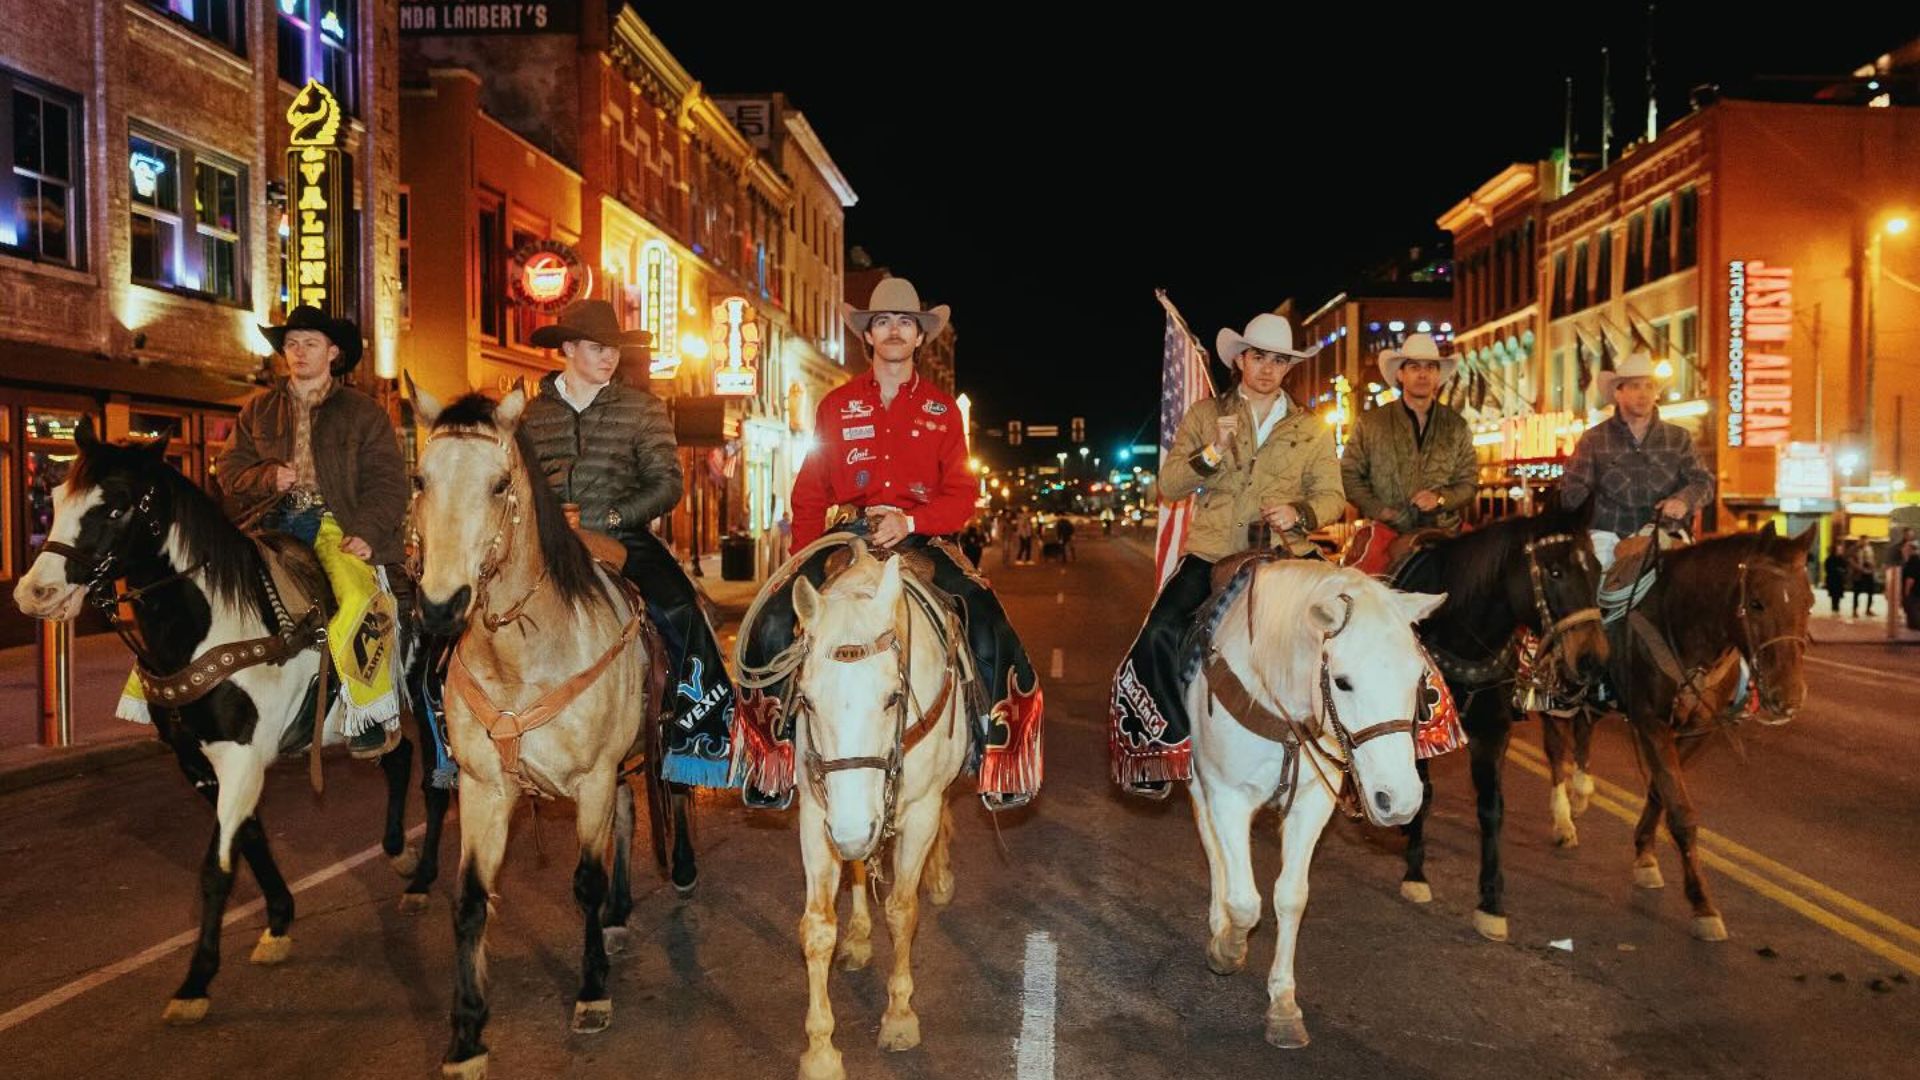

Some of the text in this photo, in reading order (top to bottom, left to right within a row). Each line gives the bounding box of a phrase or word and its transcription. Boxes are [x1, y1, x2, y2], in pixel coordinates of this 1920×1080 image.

[444, 5, 547, 29] LAMBERT'S
[1728, 261, 1744, 329] KITCHEN
[1728, 337, 1744, 414] ROOFTOP
[1744, 260, 1792, 447] JASON ALDEAN
[1727, 414, 1743, 447] BAR
[680, 684, 728, 729] VEXIL
